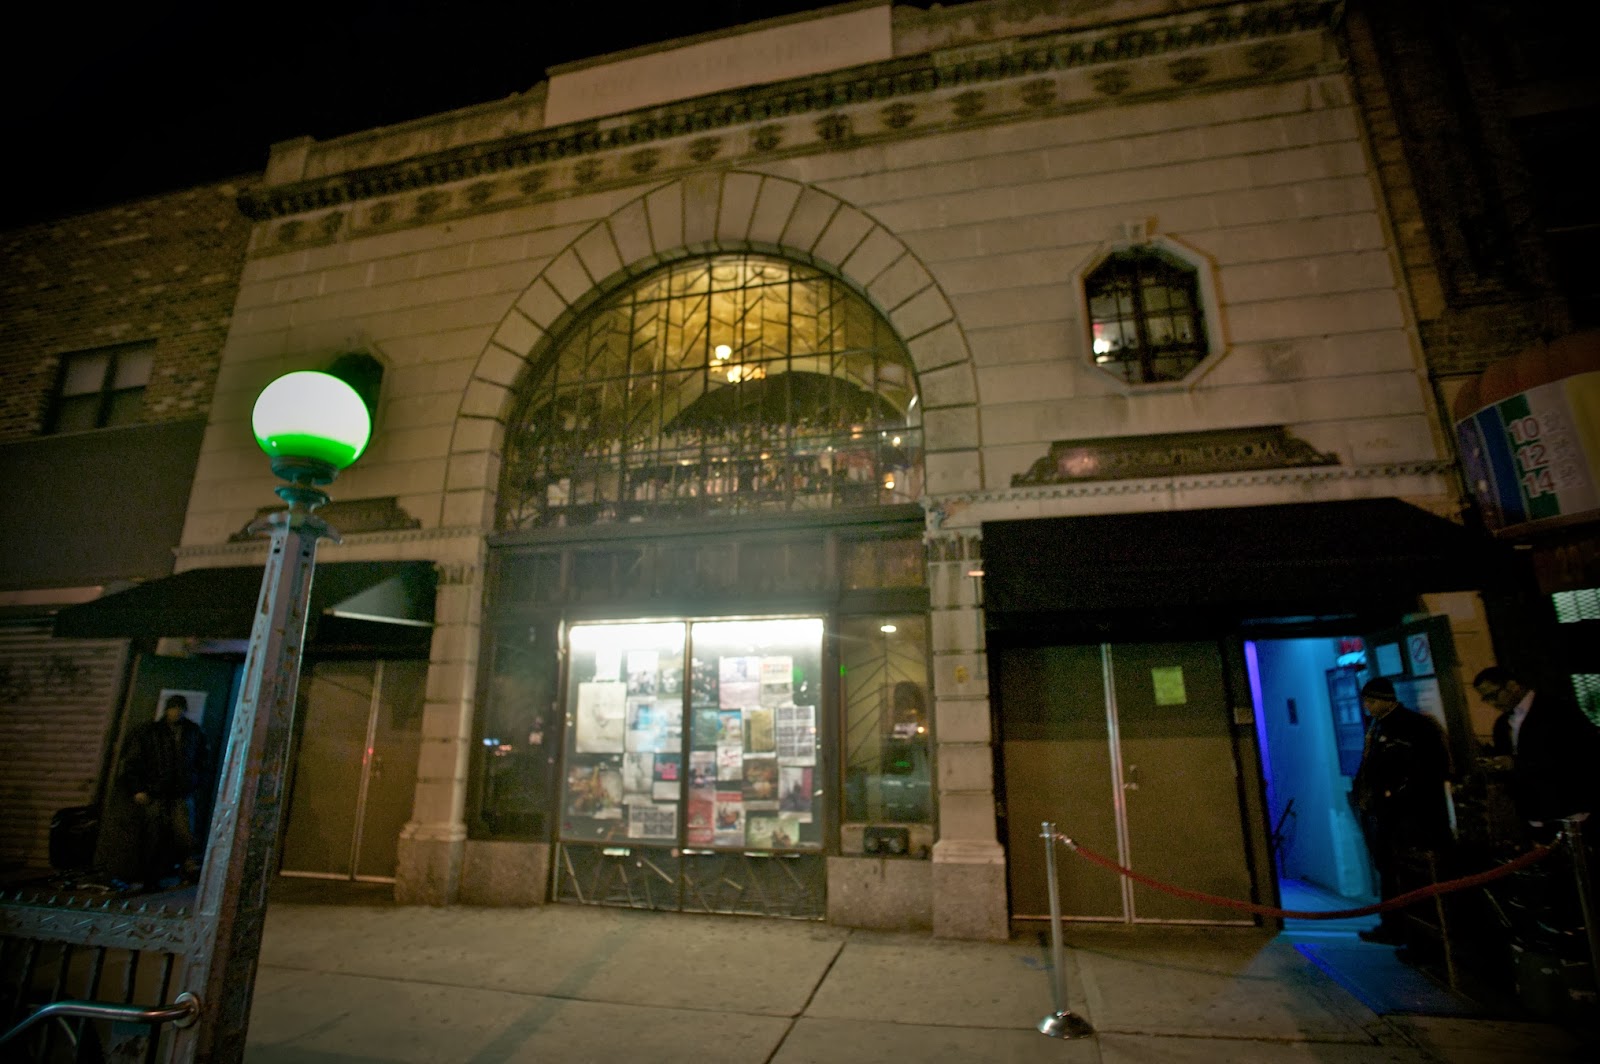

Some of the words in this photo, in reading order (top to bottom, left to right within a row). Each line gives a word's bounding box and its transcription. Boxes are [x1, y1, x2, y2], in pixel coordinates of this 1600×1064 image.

[1509, 417, 1540, 443] 10
[1518, 443, 1550, 470] 12
[1523, 468, 1555, 497] 14
